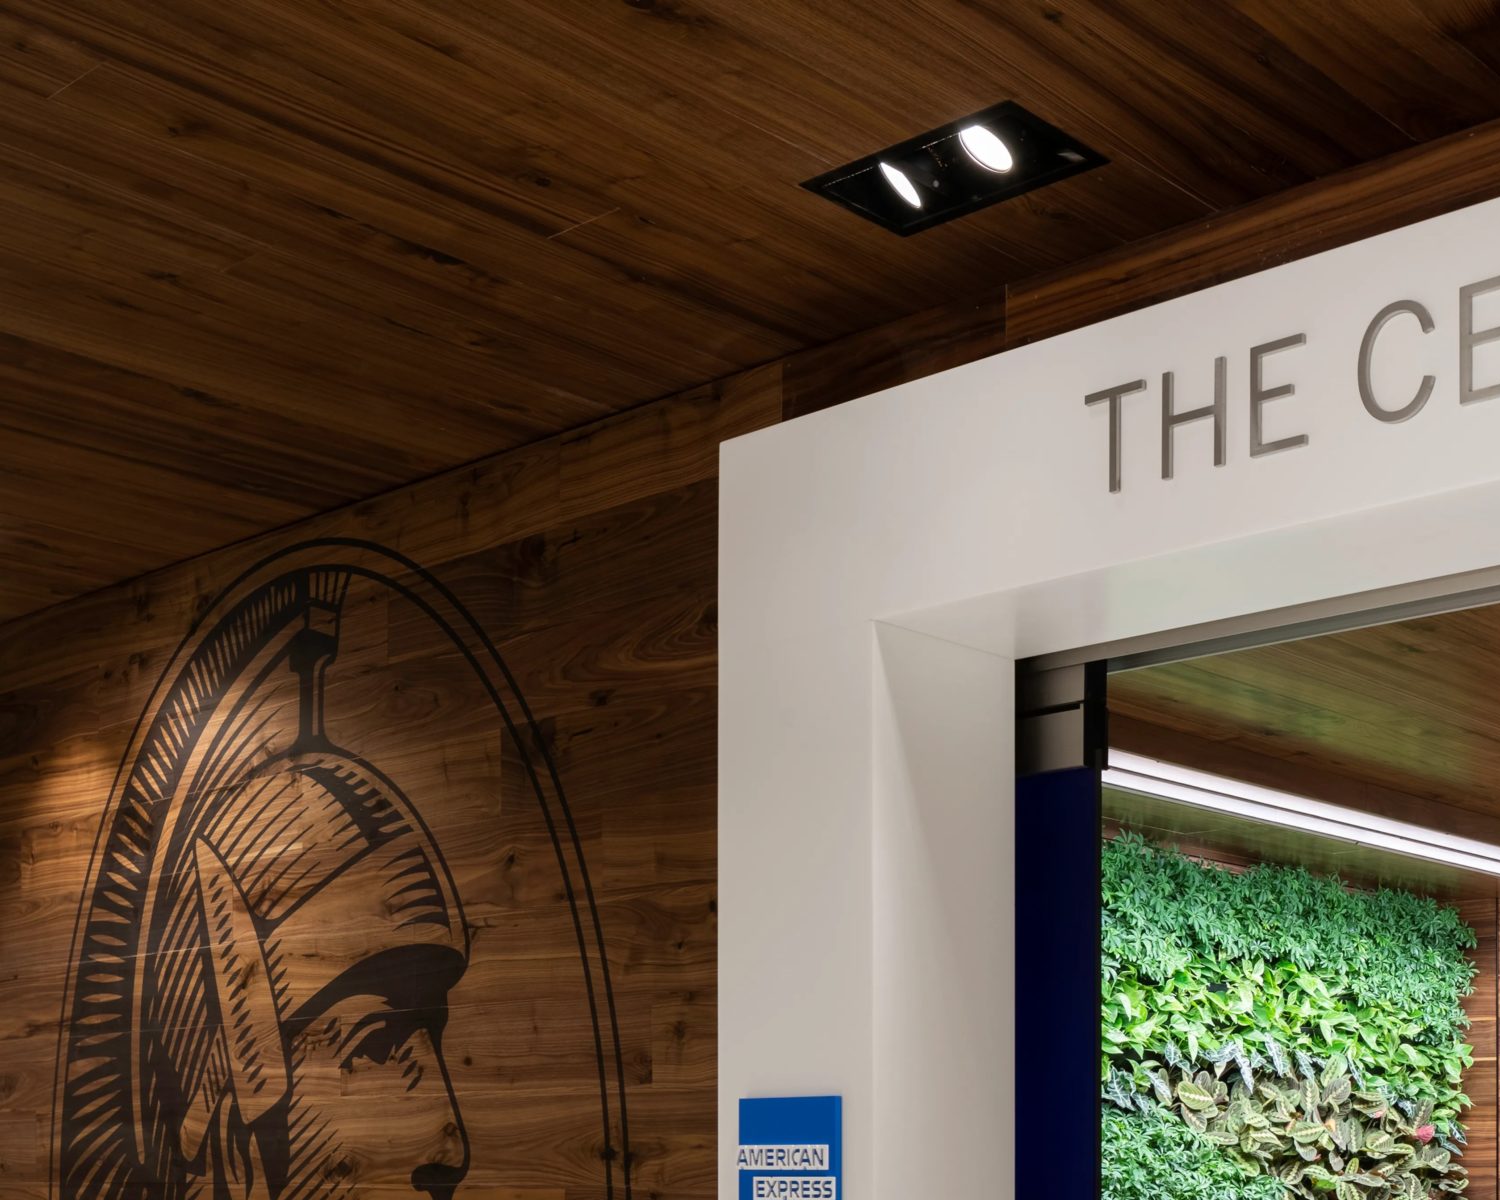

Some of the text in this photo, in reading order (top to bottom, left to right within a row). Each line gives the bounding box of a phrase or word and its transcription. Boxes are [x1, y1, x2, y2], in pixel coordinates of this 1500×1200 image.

[1085, 332, 1309, 493] THE
[737, 1148, 824, 1166] AMERICAN
[756, 1180, 833, 1198] EXPRESS
